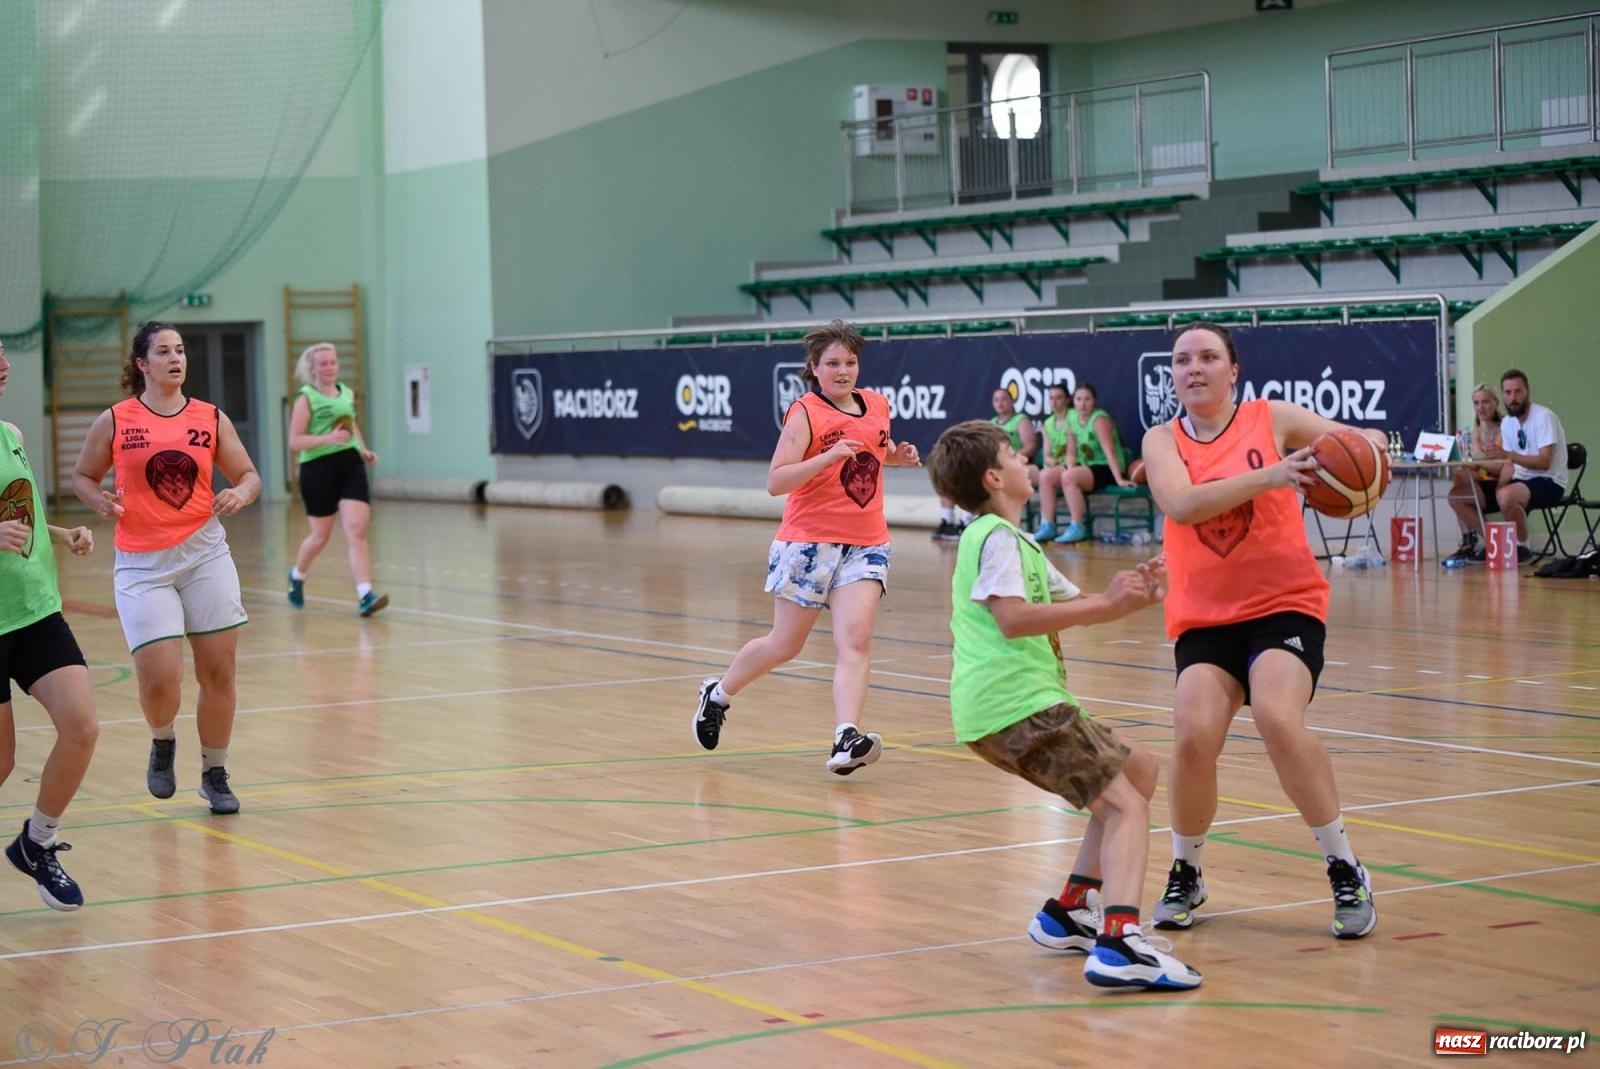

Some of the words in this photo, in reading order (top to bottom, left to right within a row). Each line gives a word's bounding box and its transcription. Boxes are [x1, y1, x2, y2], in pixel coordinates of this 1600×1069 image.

[1232, 365, 1387, 421] ACIBÓRZ
[121, 442, 151, 450] KOBIET
[187, 429, 212, 448] 22
[1246, 448, 1263, 470] 0
[1397, 521, 1417, 552] 5
